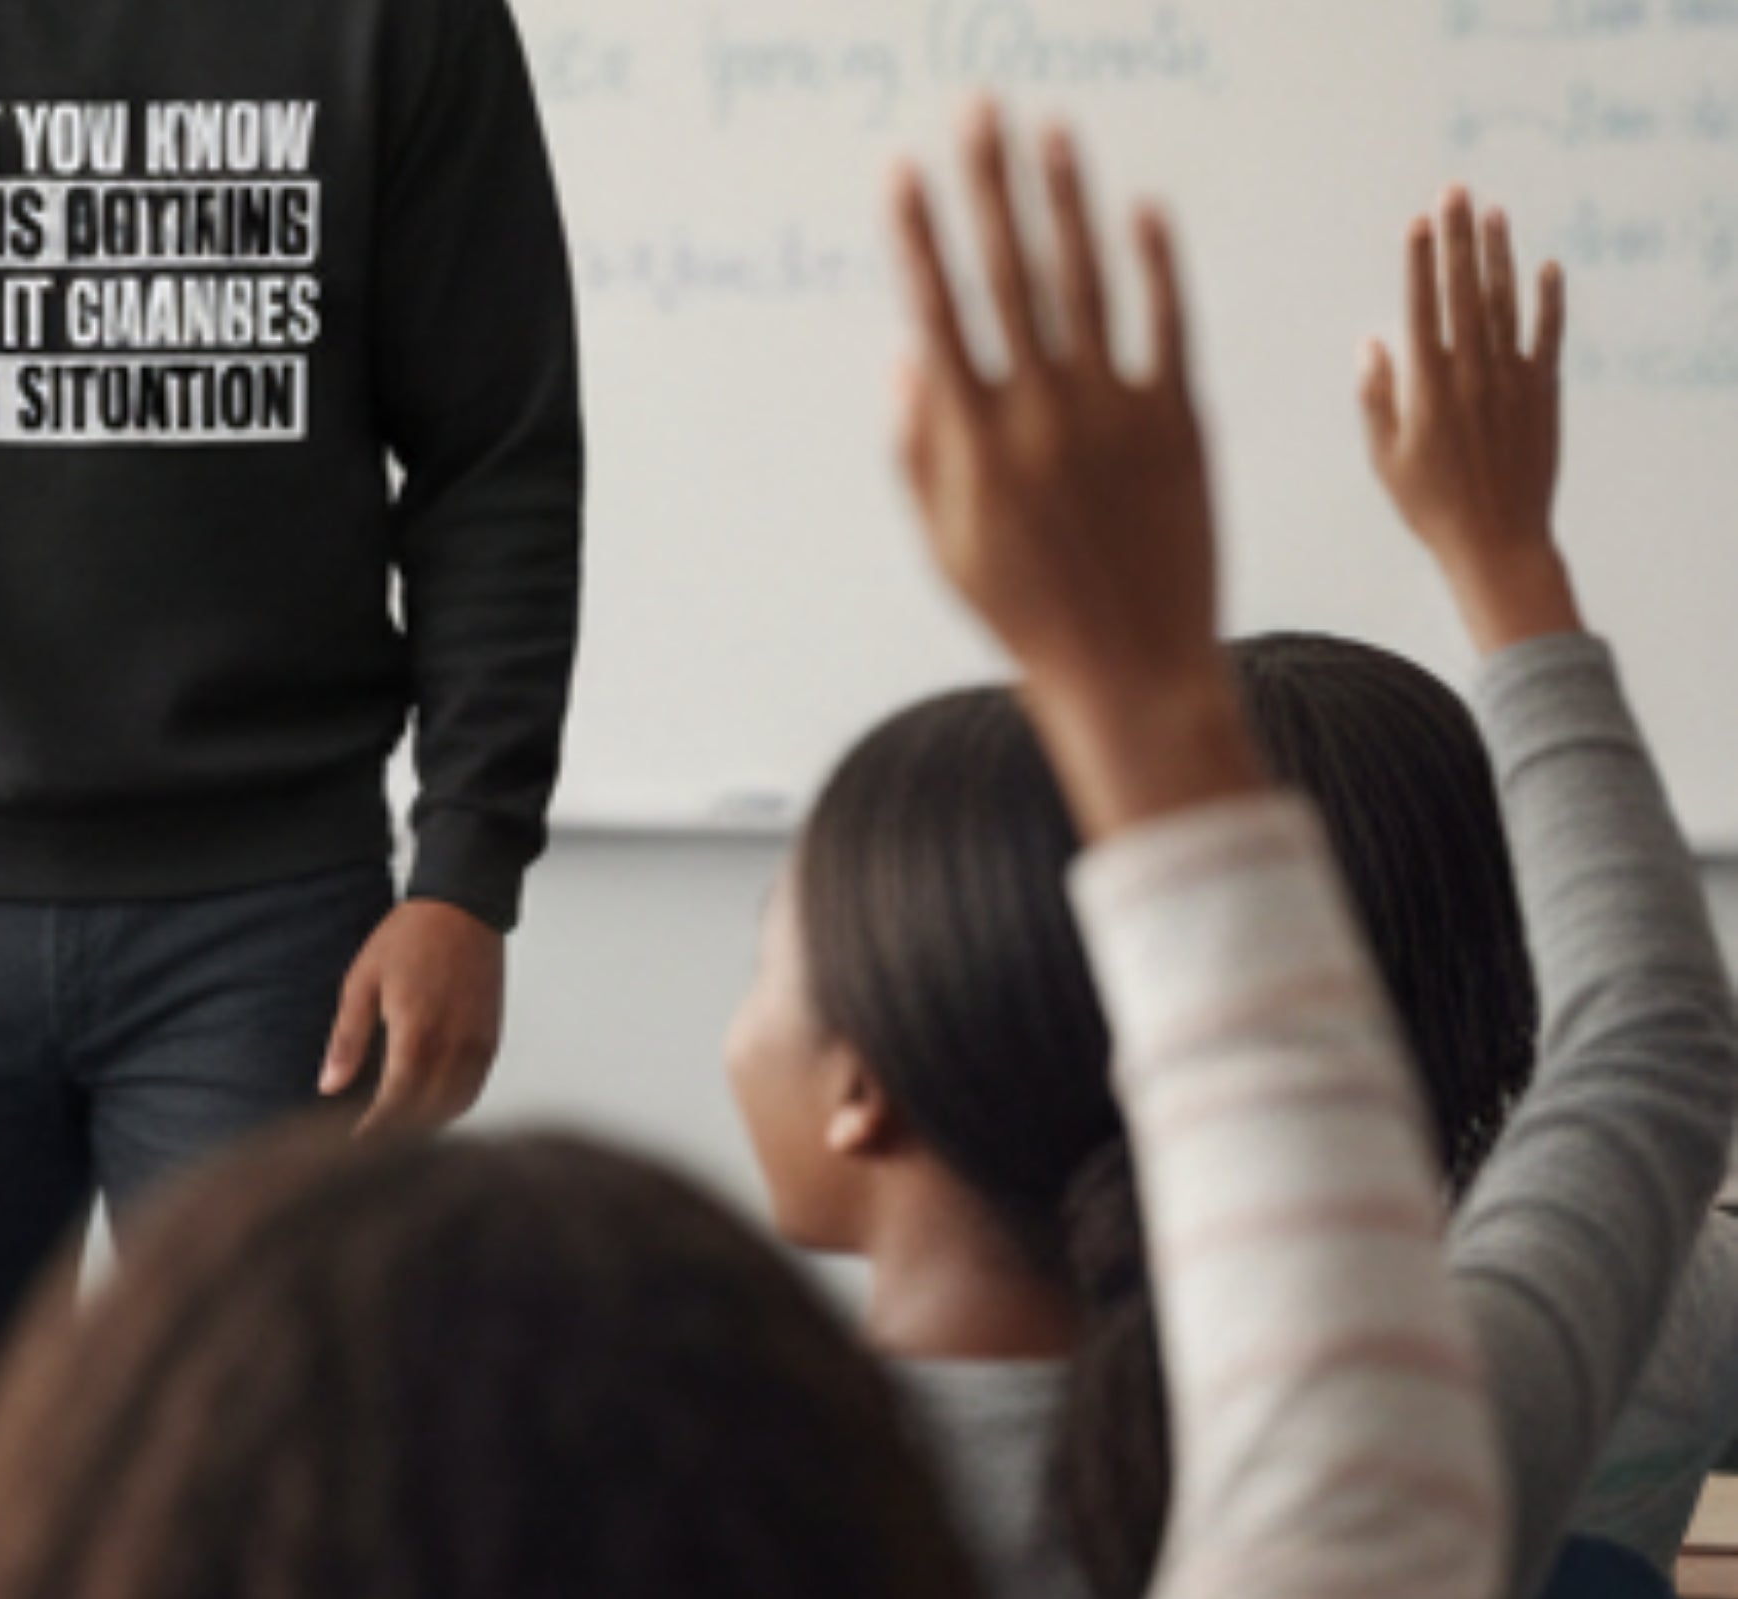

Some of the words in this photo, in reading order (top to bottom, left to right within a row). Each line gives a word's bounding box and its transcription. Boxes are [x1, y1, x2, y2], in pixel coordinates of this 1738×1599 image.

[14, 102, 129, 174] YOU
[145, 100, 317, 173] KNOW
[3, 278, 54, 349] IT
[16, 363, 296, 432] SITUATION
